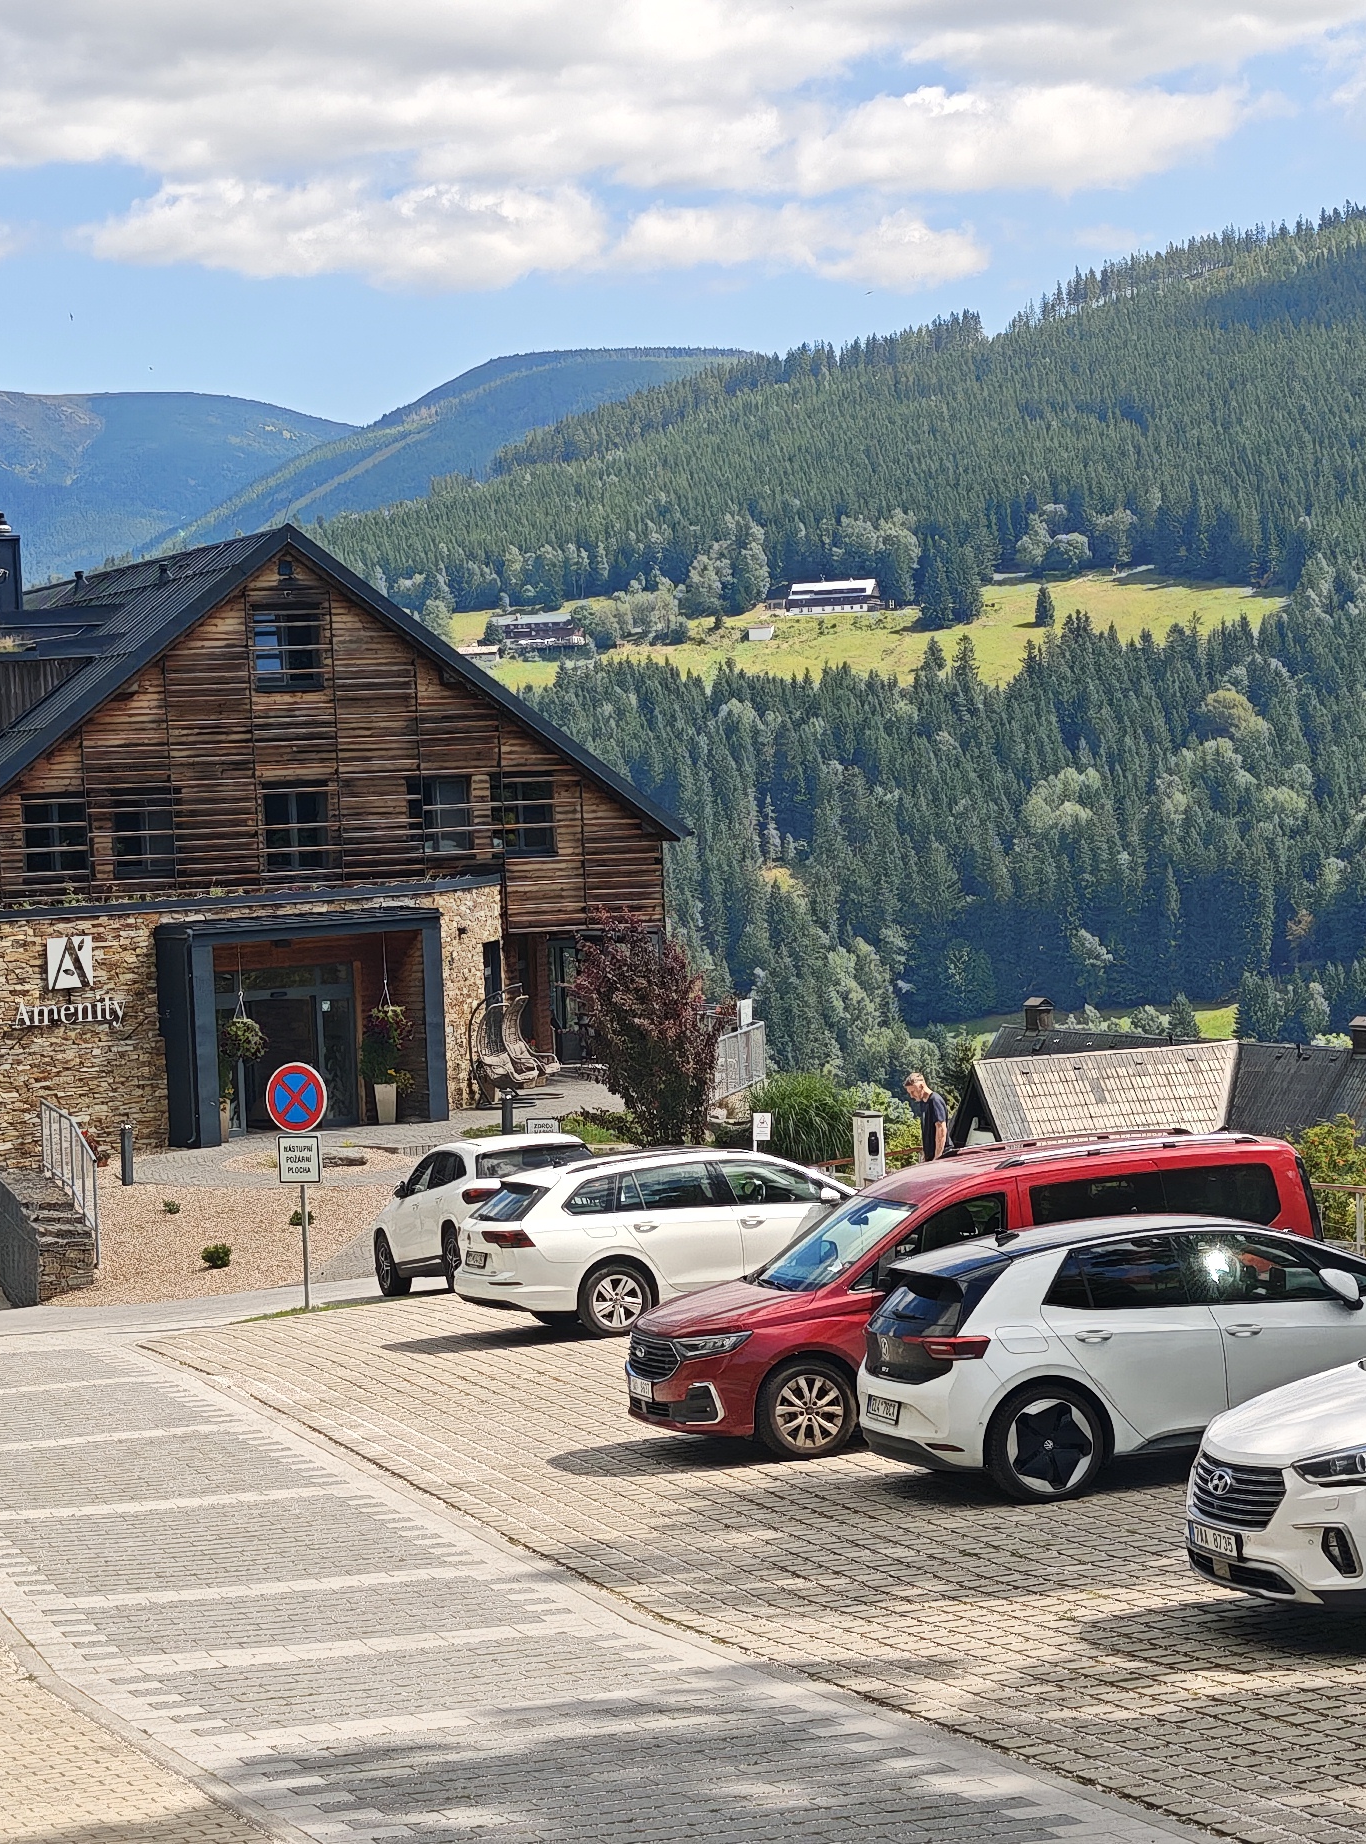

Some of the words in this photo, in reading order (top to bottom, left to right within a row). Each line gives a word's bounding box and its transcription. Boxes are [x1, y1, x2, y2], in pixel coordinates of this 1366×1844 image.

[12, 995, 126, 1027] Amenity
[287, 1166, 311, 1174] PLOCHA
[1194, 1526, 1209, 1546] 7AA
[1213, 1533, 1233, 1553] 8735
